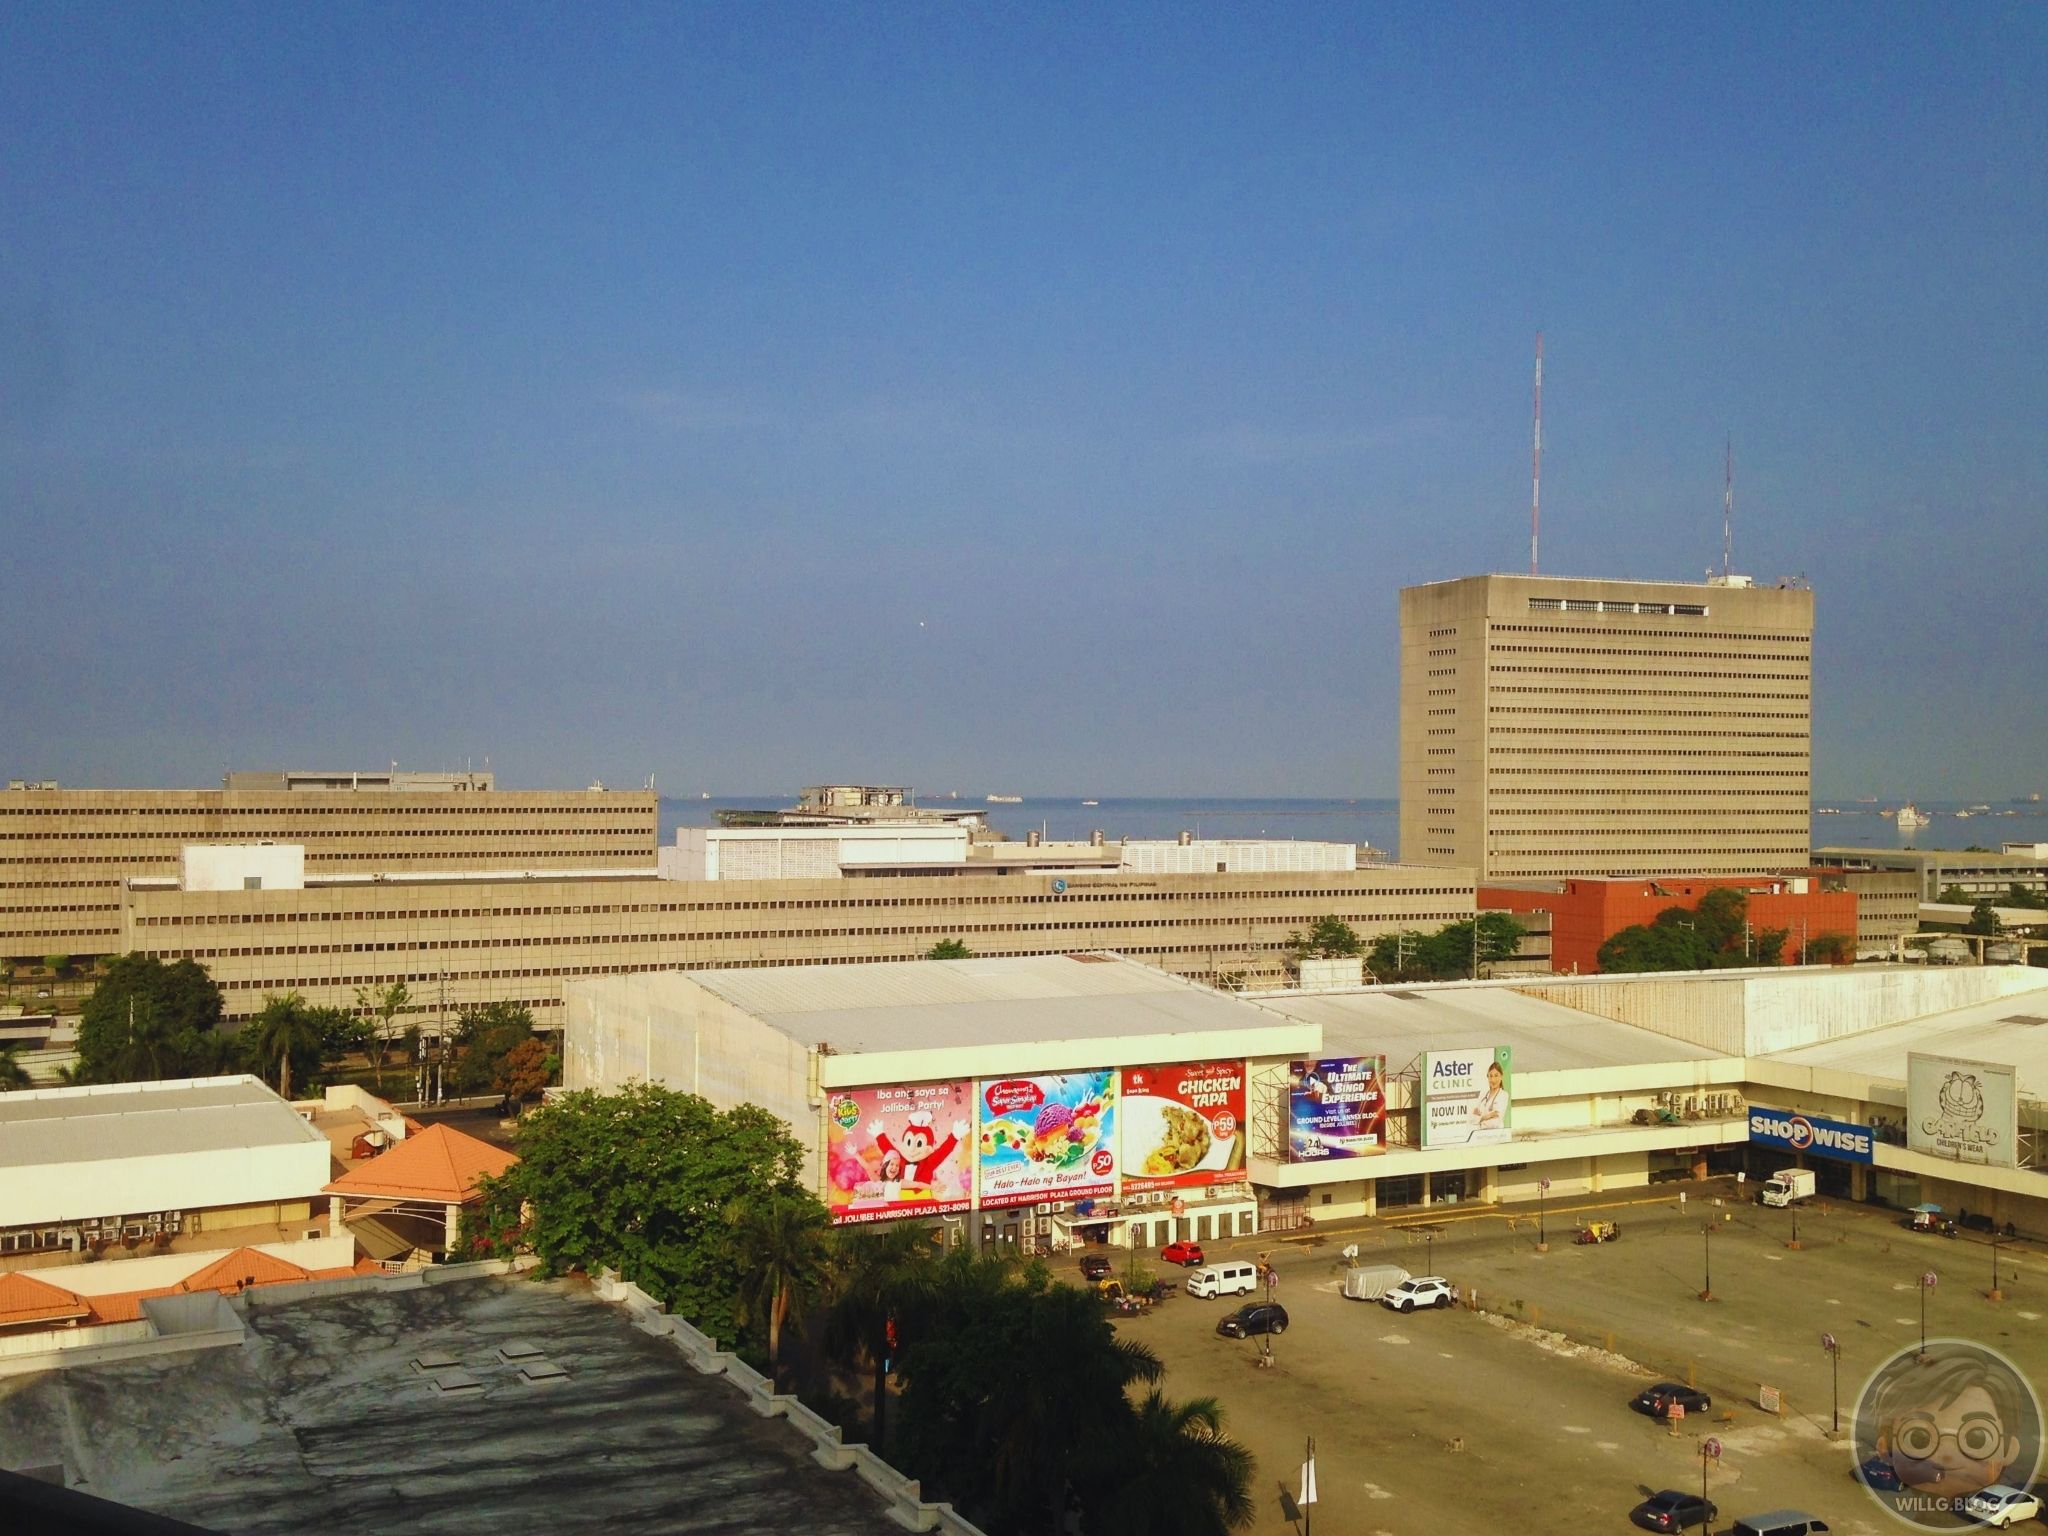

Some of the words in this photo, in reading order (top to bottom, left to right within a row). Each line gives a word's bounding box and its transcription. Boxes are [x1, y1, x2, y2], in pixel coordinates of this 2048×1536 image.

[1342, 1063, 1358, 1073] THE
[1433, 1060, 1474, 1078] Aster
[1327, 1071, 1372, 1083] ULTIMATE
[1433, 1078, 1473, 1090] CLINIC
[1177, 1076, 1241, 1095] CHICKEN
[1334, 1082, 1365, 1094] BINGO
[877, 1090, 892, 1100] Iba
[915, 1088, 936, 1098] saya
[938, 1087, 949, 1096] sa
[1191, 1091, 1228, 1108] TAPA
[1321, 1091, 1378, 1105] EXPERIENCE
[880, 1102, 916, 1113] Jollibee
[918, 1099, 945, 1111] Party!
[1431, 1105, 1455, 1118] NOW
[1457, 1104, 1468, 1116] IN
[1296, 1115, 1323, 1125] GROUND
[1751, 1115, 1870, 1154] SHOPWISE
[1921, 1117, 1999, 1146] GARFIELD
[1298, 1147, 1330, 1158] HOURS
[1936, 1138, 1967, 1151] CHILDREN'S
[1967, 1143, 1984, 1153] WEAR
[1042, 1176, 1054, 1187] ng
[1056, 1170, 1087, 1185] Bayan!
[982, 1196, 1010, 1207] LOCATED
[1010, 1195, 1017, 1203] AT
[1018, 1193, 1049, 1202] HARRISON
[1049, 1190, 1069, 1199] PLAZA
[1069, 1187, 1094, 1197] GROUND
[1094, 1185, 1113, 1194] FLOOR
[843, 1211, 874, 1224] JOLLIBEE
[875, 1207, 914, 1220] HARRISON
[914, 1204, 937, 1216] PLAZA
[938, 1201, 970, 1213] 521-8098
